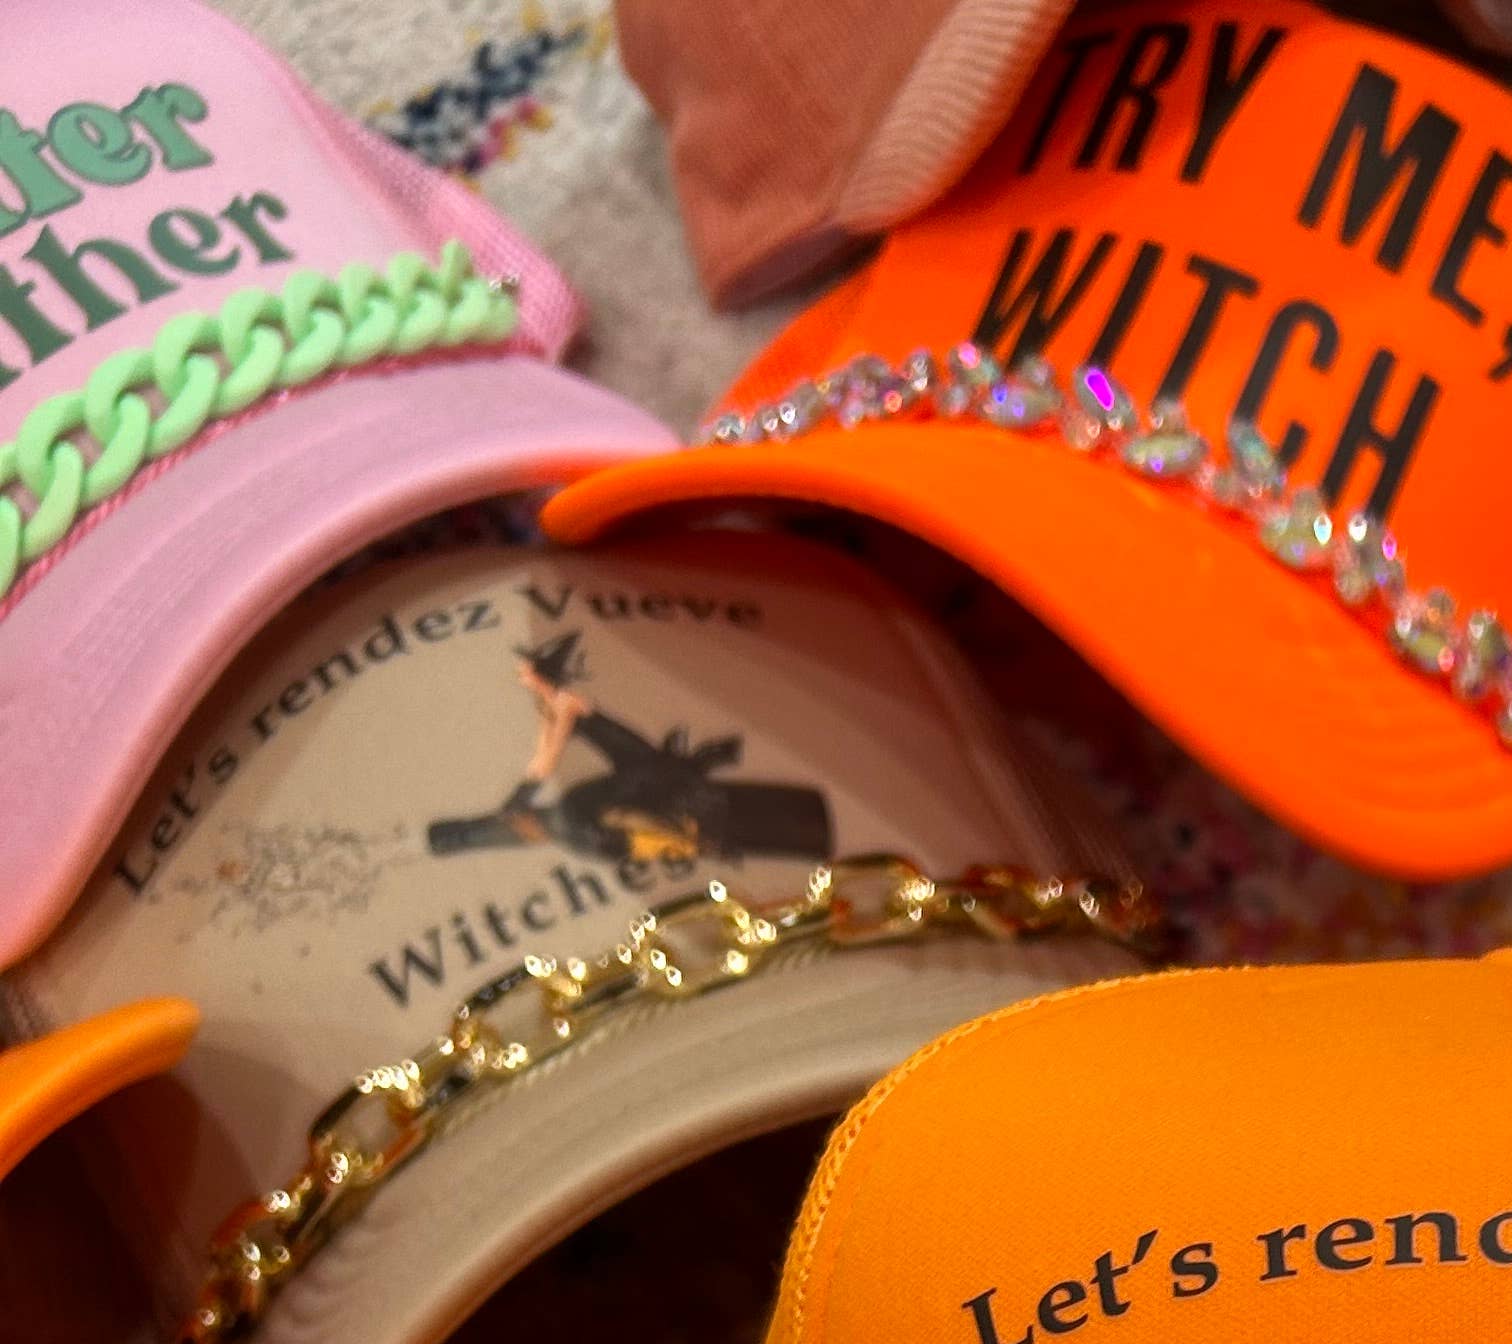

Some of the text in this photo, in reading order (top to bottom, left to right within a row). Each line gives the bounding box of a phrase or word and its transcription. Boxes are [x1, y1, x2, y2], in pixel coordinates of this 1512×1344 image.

[1017, 20, 1288, 185] TRY
[0, 190, 295, 390] ther
[971, 225, 1442, 526] WITCH
[114, 582, 762, 896] Let's rendez Vueve
[368, 852, 697, 1009] Witches
